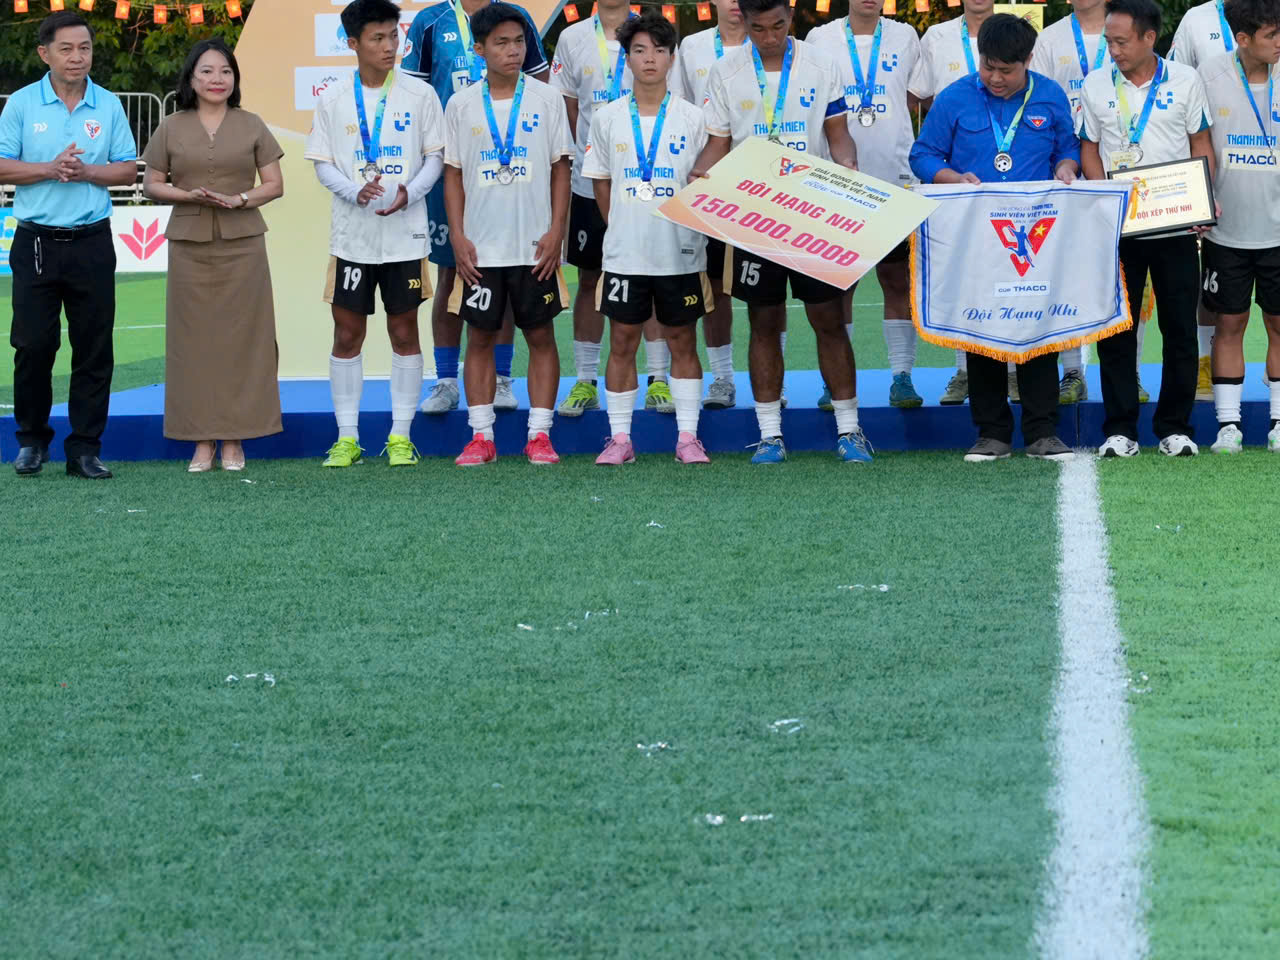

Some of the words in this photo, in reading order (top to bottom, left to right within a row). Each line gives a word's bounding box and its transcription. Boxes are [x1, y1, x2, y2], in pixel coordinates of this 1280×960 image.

[736, 179, 773, 198] ĐỘI
[770, 191, 826, 219] HẠNG
[825, 212, 867, 234] NHÌ
[845, 194, 877, 209] THACO
[429, 220, 449, 246] 23
[577, 230, 588, 251] 9
[690, 193, 860, 267] 150.000.000Đ
[343, 266, 362, 291] 19
[740, 260, 762, 286] 15
[1203, 268, 1219, 293] 16
[466, 285, 492, 311] 20
[608, 277, 629, 302] 21
